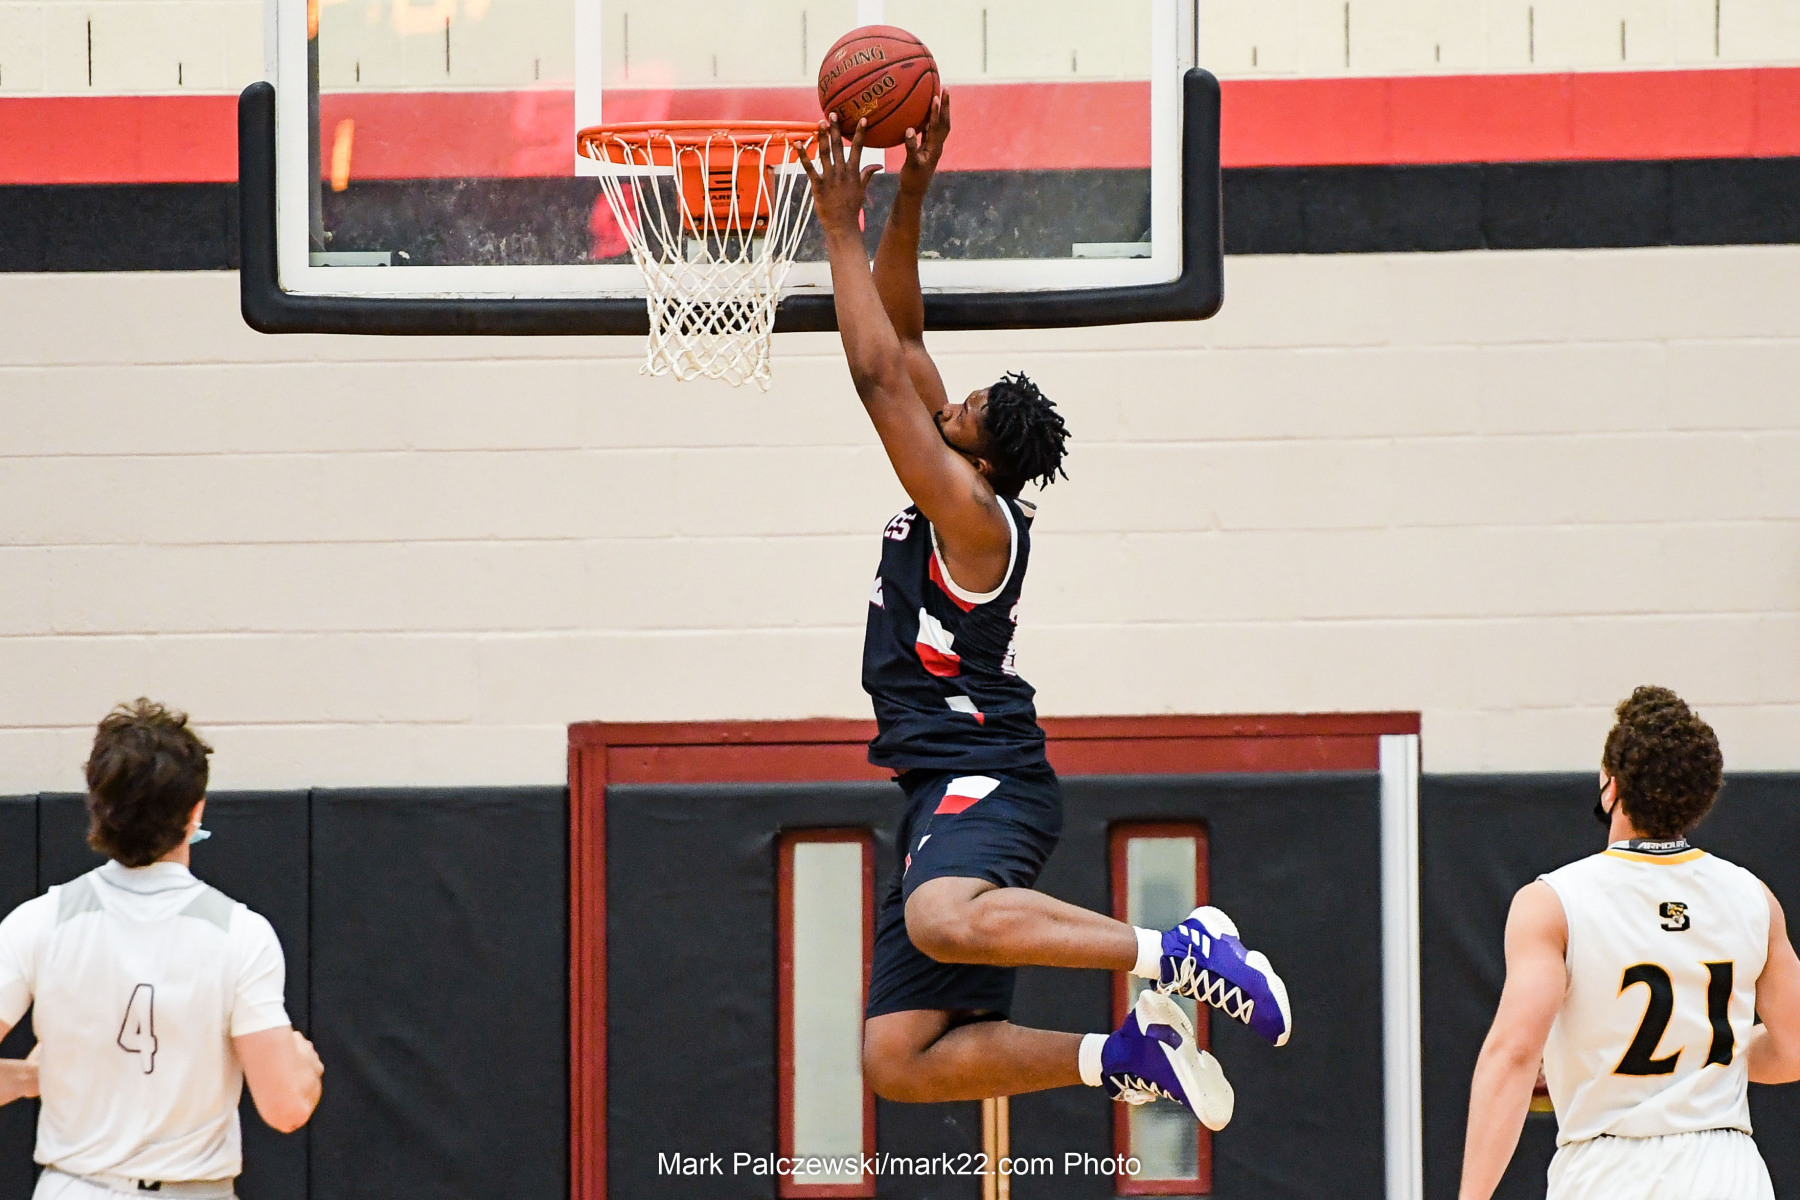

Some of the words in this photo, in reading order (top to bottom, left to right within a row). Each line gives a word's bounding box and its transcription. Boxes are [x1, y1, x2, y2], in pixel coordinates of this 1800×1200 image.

[819, 45, 886, 97] SPALDING
[851, 75, 895, 110] 1000
[1637, 840, 1686, 850] ARMOUR
[117, 983, 158, 1075] 4
[1611, 959, 1736, 1075] 21
